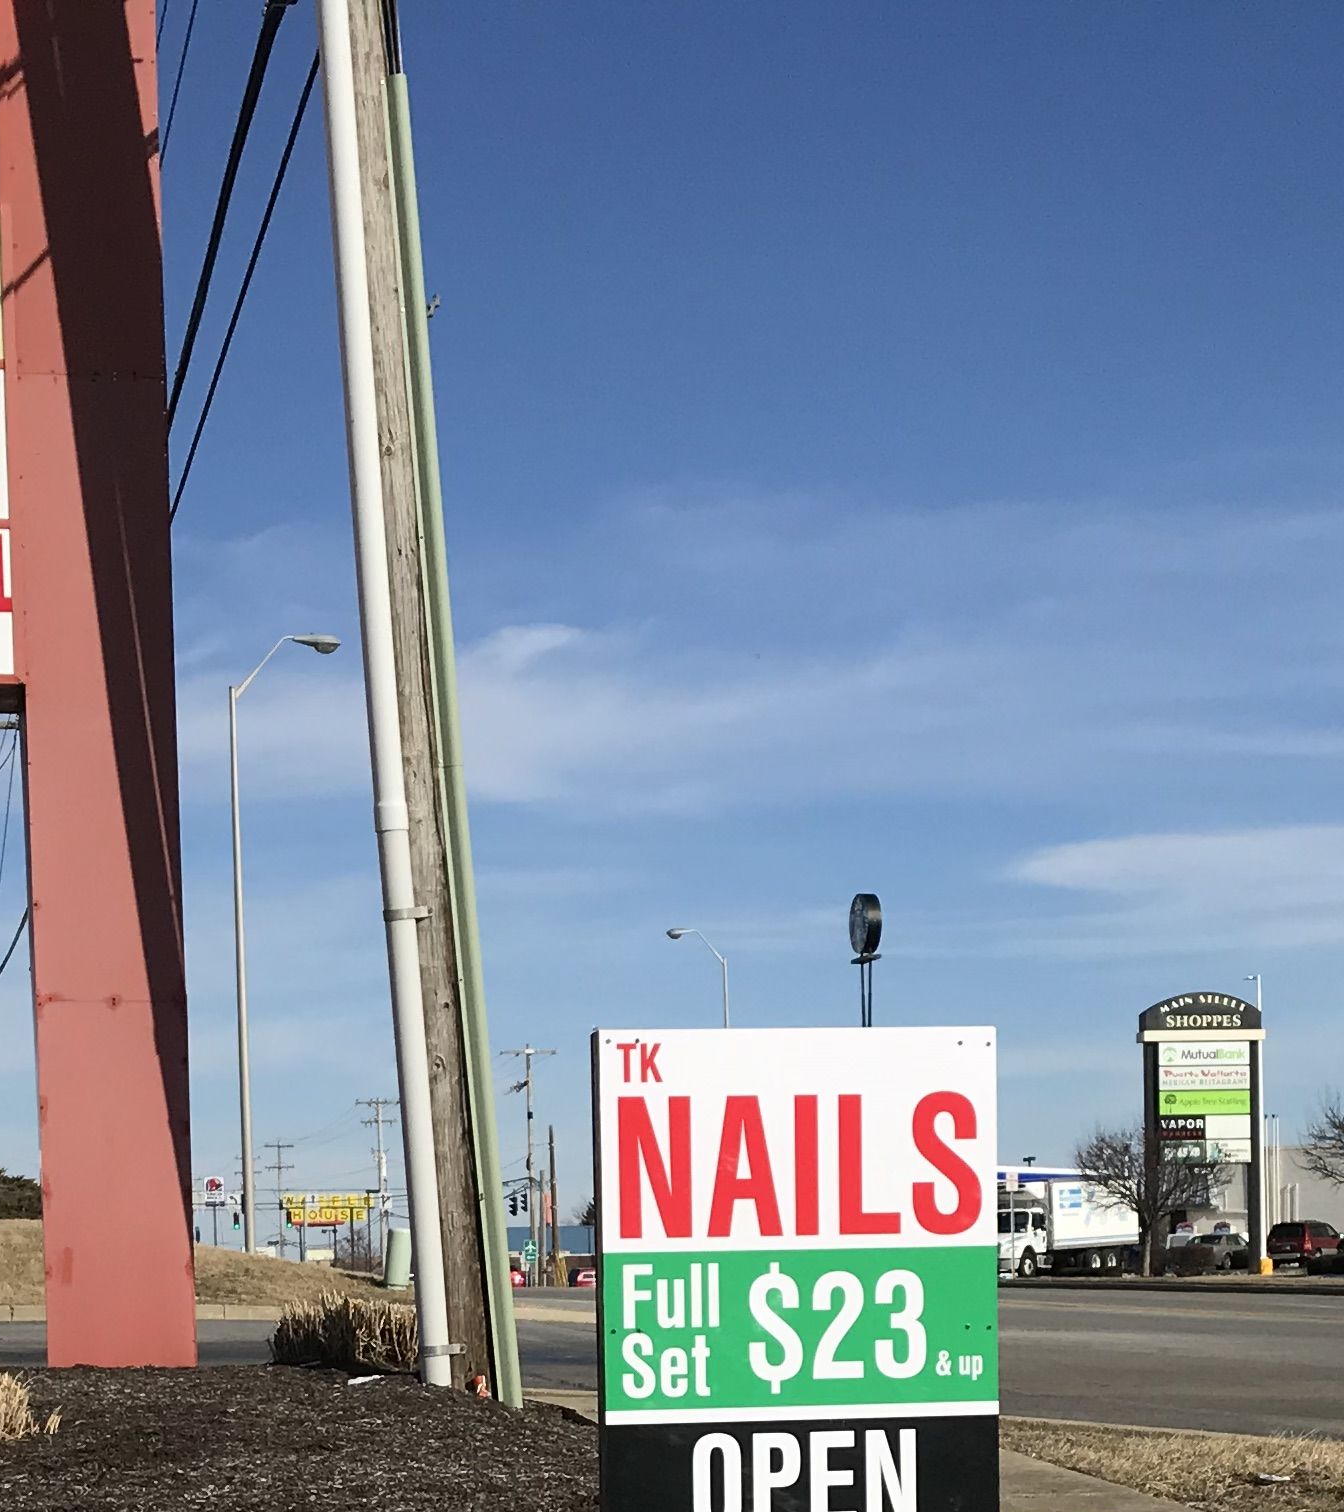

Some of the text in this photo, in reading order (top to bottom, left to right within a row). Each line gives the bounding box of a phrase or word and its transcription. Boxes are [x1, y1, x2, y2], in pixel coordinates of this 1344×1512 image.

[1166, 1014, 1242, 1028] SHOPPES
[616, 1043, 662, 1083] TK
[1181, 1048, 1246, 1060] MutualBank
[1161, 1119, 1204, 1129] VAPOR
[618, 1091, 982, 1239] NAILS
[293, 1210, 364, 1220] HOUSE
[621, 1261, 927, 1394] Full $23
[621, 1332, 983, 1398] Set & up
